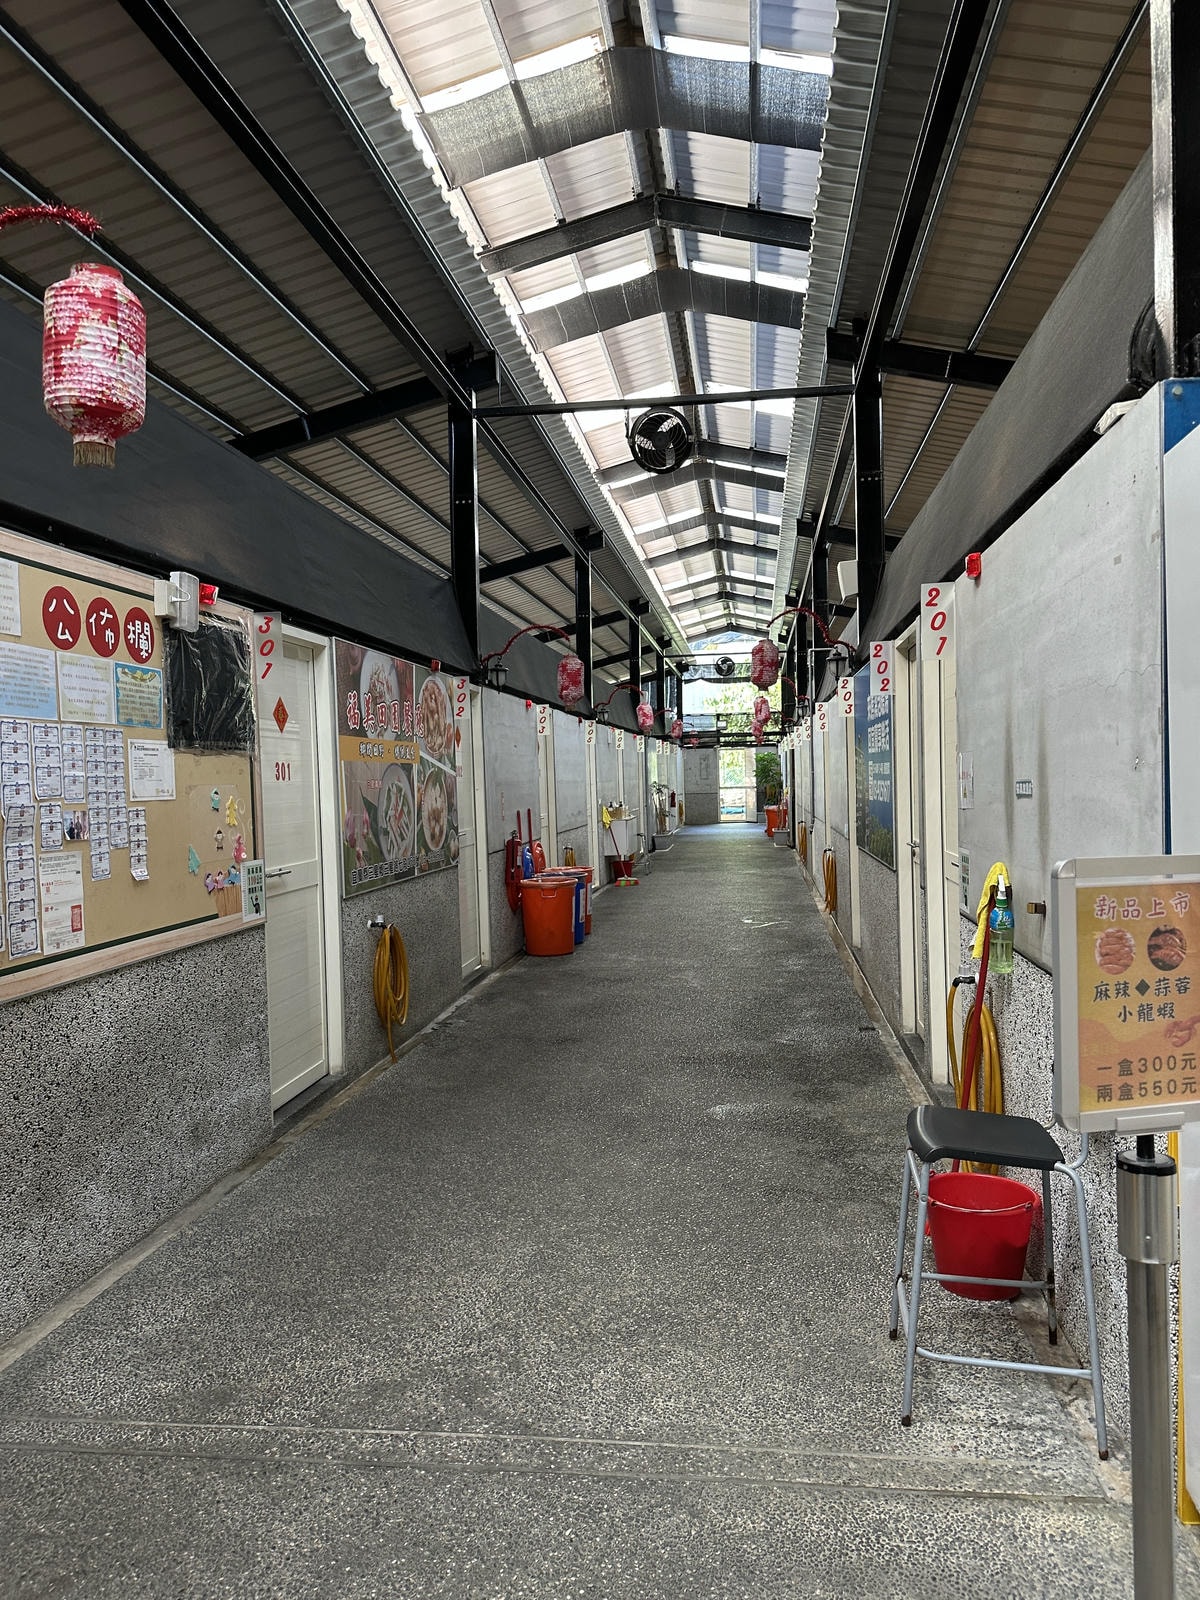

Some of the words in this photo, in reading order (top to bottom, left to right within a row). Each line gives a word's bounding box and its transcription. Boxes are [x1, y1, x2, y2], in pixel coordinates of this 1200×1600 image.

[48, 598, 152, 659] 公佈欄
[925, 587, 948, 656] 201
[258, 616, 275, 680] 301
[872, 643, 890, 692] 202
[456, 678, 467, 718] 302
[841, 678, 853, 714] 203
[538, 706, 547, 734] 303
[803, 718, 811, 740] 206
[817, 703, 827, 730] 205
[586, 720, 595, 744] 305
[275, 762, 291, 782] 301
[1094, 892, 1191, 921] 新品上市
[1117, 1001, 1176, 1024] 小龍蝦
[1097, 1052, 1197, 1078] 一盒300元
[1097, 1076, 1197, 1103] 兩盒550元
